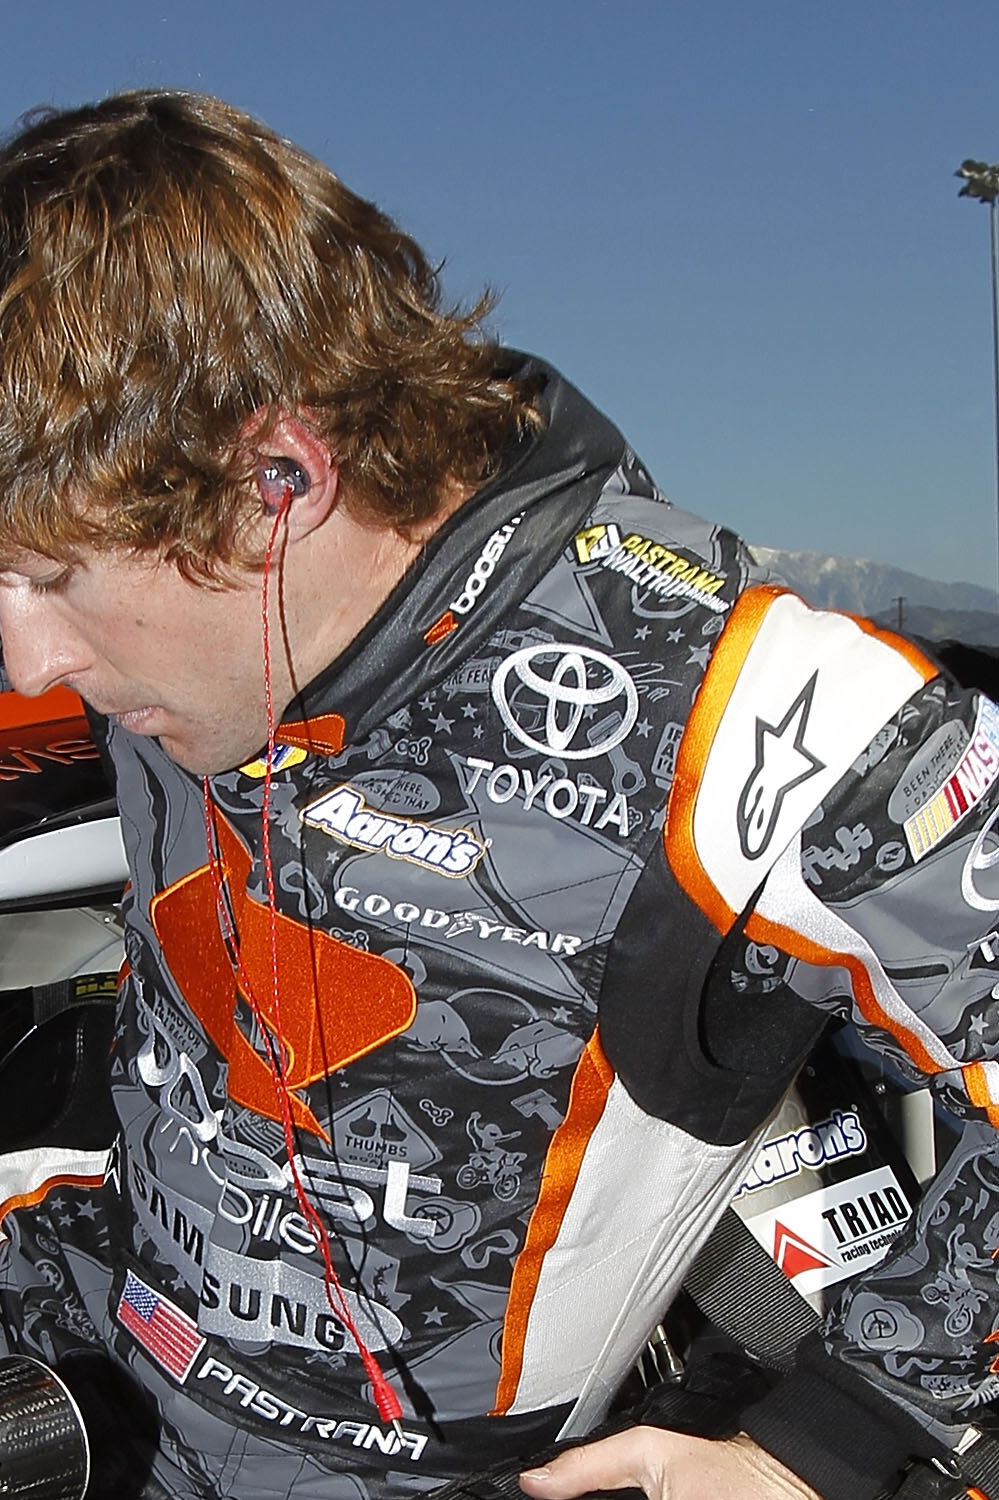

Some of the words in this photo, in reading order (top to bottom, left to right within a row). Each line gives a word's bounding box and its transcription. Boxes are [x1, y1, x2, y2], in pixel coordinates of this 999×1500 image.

[621, 534, 726, 594] PASTRANA
[465, 756, 630, 838] TOYOTA
[903, 767, 931, 798] BEEN
[302, 785, 486, 877] Aaron's
[334, 886, 584, 956] GOODYEAR
[345, 1134, 408, 1158] THUMBS
[821, 1186, 910, 1244] TRIAD
[841, 1241, 873, 1263] racing
[197, 1356, 429, 1461] PASTRANA
